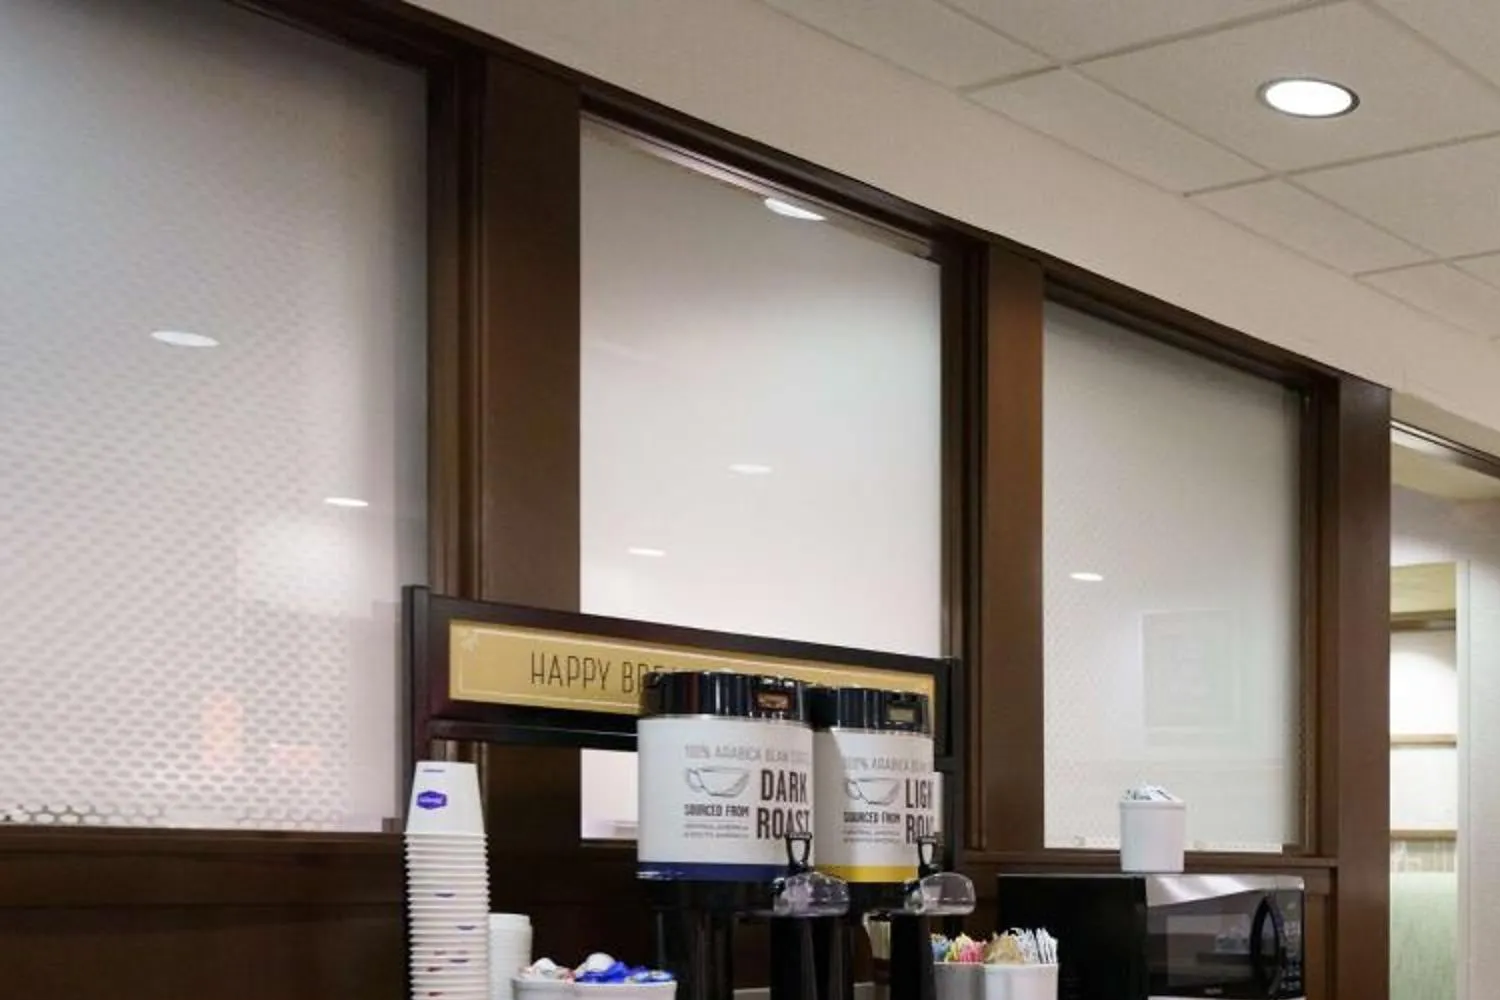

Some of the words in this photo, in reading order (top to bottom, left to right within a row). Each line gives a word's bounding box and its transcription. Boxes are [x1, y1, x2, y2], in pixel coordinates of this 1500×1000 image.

[530, 651, 611, 691] HAPPY
[760, 769, 808, 802] DARK
[725, 805, 750, 817] FROM
[756, 807, 811, 840] ROAST
